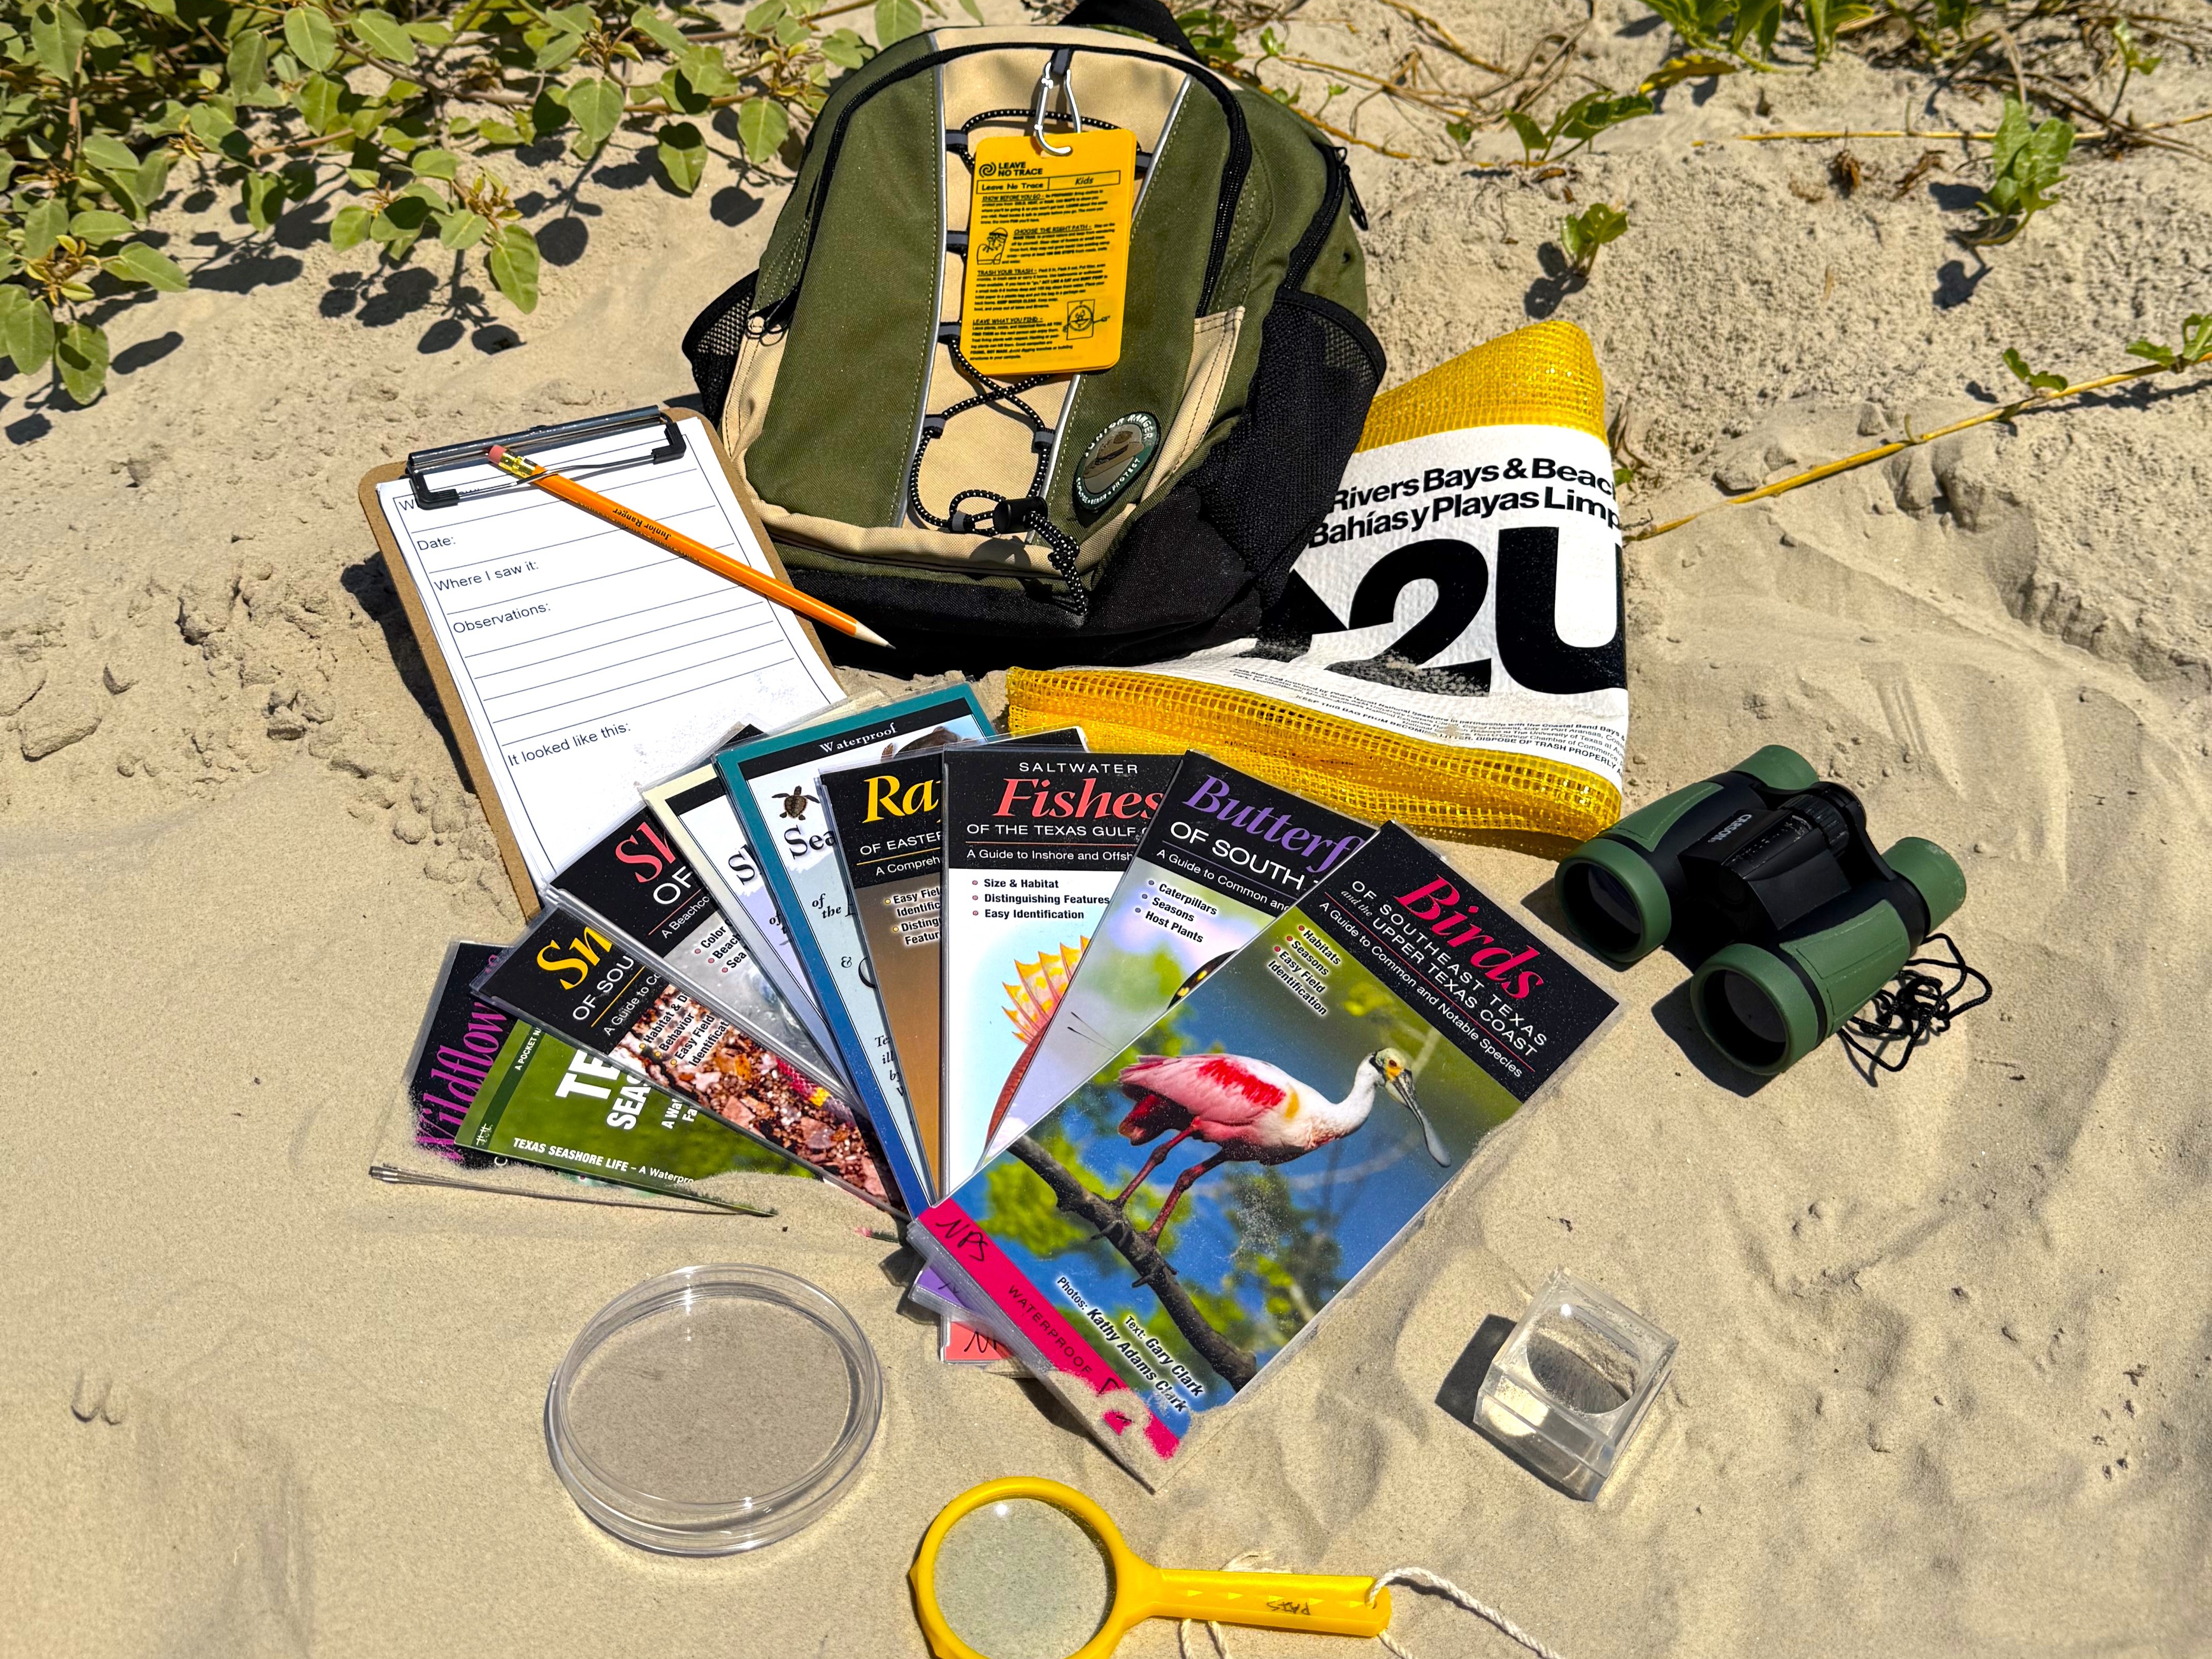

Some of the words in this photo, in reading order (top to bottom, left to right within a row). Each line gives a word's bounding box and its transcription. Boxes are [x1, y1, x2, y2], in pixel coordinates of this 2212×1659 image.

[1075, 177, 1094, 185] Kids
[1127, 414, 1153, 439] RANGER
[1330, 477, 1419, 513] Rivers
[1423, 462, 1499, 494] Bays
[1502, 457, 1529, 480] &
[1531, 457, 1617, 502] Beac
[612, 508, 643, 527] Ranger
[1411, 505, 1430, 532] y
[1432, 487, 1539, 522] Playas
[417, 535, 456, 551] Date:
[644, 523, 671, 541] Junior
[434, 570, 482, 591] Where
[485, 571, 491, 581] I
[495, 564, 522, 579] saw
[525, 561, 539, 571] it:
[453, 602, 551, 634] Observations:
[508, 754, 520, 766] It
[522, 738, 571, 762] looked
[573, 731, 598, 748] like
[600, 722, 631, 739] this:
[819, 722, 897, 754] Waterproof
[1019, 762, 1138, 774] SALTWATER
[1535, 740, 1567, 752] TRASH
[1569, 747, 1616, 769] PROPERLY
[991, 778, 1164, 820] Fishes
[967, 824, 989, 834] OF
[995, 825, 1028, 835] THE
[1034, 825, 1086, 836] TEXAS
[1092, 826, 1136, 837] GULF
[860, 843, 881, 855] OF
[967, 849, 976, 859] A
[979, 849, 1013, 859] Guide
[1017, 851, 1028, 859] to
[1032, 850, 1074, 860] Inshore
[1078, 851, 1099, 861] and
[1171, 821, 1209, 844] OF
[1212, 839, 1305, 890] SOUTH
[653, 866, 693, 905] OF
[876, 866, 885, 876] A
[984, 879, 1006, 889] Size
[1009, 879, 1017, 888] &
[1021, 879, 1059, 889] Habitat
[1157, 849, 1165, 859] A
[1168, 854, 1201, 874] Guide
[1204, 869, 1214, 879] to
[1218, 876, 1268, 903] Common
[812, 893, 826, 909] of
[821, 906, 842, 919] the
[893, 893, 918, 905] Easy
[984, 894, 1061, 905] Distinguishing
[1064, 895, 1110, 904] Features
[985, 909, 1009, 920] Easy
[1013, 910, 1084, 919] Identification
[1152, 897, 1195, 922] Seasons
[1159, 883, 1218, 915] Caterpillars
[661, 929, 672, 939] A
[669, 896, 710, 930] Beachco
[1145, 911, 1170, 927] Host
[1171, 922, 1204, 943] Plants
[701, 926, 726, 949] Color
[1303, 930, 1341, 965] Habitats
[1394, 874, 1544, 999] Birds
[726, 952, 747, 969] Sea
[1279, 951, 1302, 973] Easy
[1301, 971, 1326, 993] Field
[1291, 940, 1329, 976] Seasons
[1341, 890, 1362, 905] and
[1358, 903, 1373, 917] the
[1372, 917, 1425, 964] UPPER
[1428, 962, 1478, 1008] TEXAS
[1480, 1009, 1538, 1056] COAST
[1352, 881, 1377, 899] OF
[1379, 904, 1485, 991] SOUTHEAST
[1490, 994, 1547, 1046] TEXAS
[1268, 960, 1328, 1016] Identification
[1319, 902, 1330, 912] A
[1330, 909, 1359, 937] Guide
[1359, 935, 1371, 947] to
[1371, 945, 1417, 987] Common
[1416, 986, 1440, 1006] and
[1437, 1003, 1479, 1041] Notable
[1479, 1038, 1523, 1078] Species
[573, 994, 596, 1020] OF
[604, 1028, 615, 1036] A
[611, 998, 640, 1025] Guide
[637, 987, 650, 997] to
[643, 1010, 674, 1044] Habitat
[658, 1013, 694, 1051] Behavior
[674, 1037, 698, 1060] Easy
[692, 1015, 715, 1038] Field
[518, 1036, 538, 1065] POCKET
[661, 1118, 675, 1130] A
[513, 1137, 547, 1154] TEXAS
[548, 1145, 604, 1166] SEASHORE
[606, 1158, 629, 1172] LIFE
[638, 1165, 646, 1174] A
[1008, 1285, 1093, 1374] WATERPROOF
[1057, 1277, 1088, 1310] Photos:
[1087, 1308, 1120, 1341] Kathy
[1117, 1342, 1157, 1380] Adams
[1156, 1380, 1188, 1412] Clark
[1125, 1315, 1146, 1339] Text:
[1145, 1338, 1174, 1365] Gary
[1172, 1365, 1204, 1397] Clark
